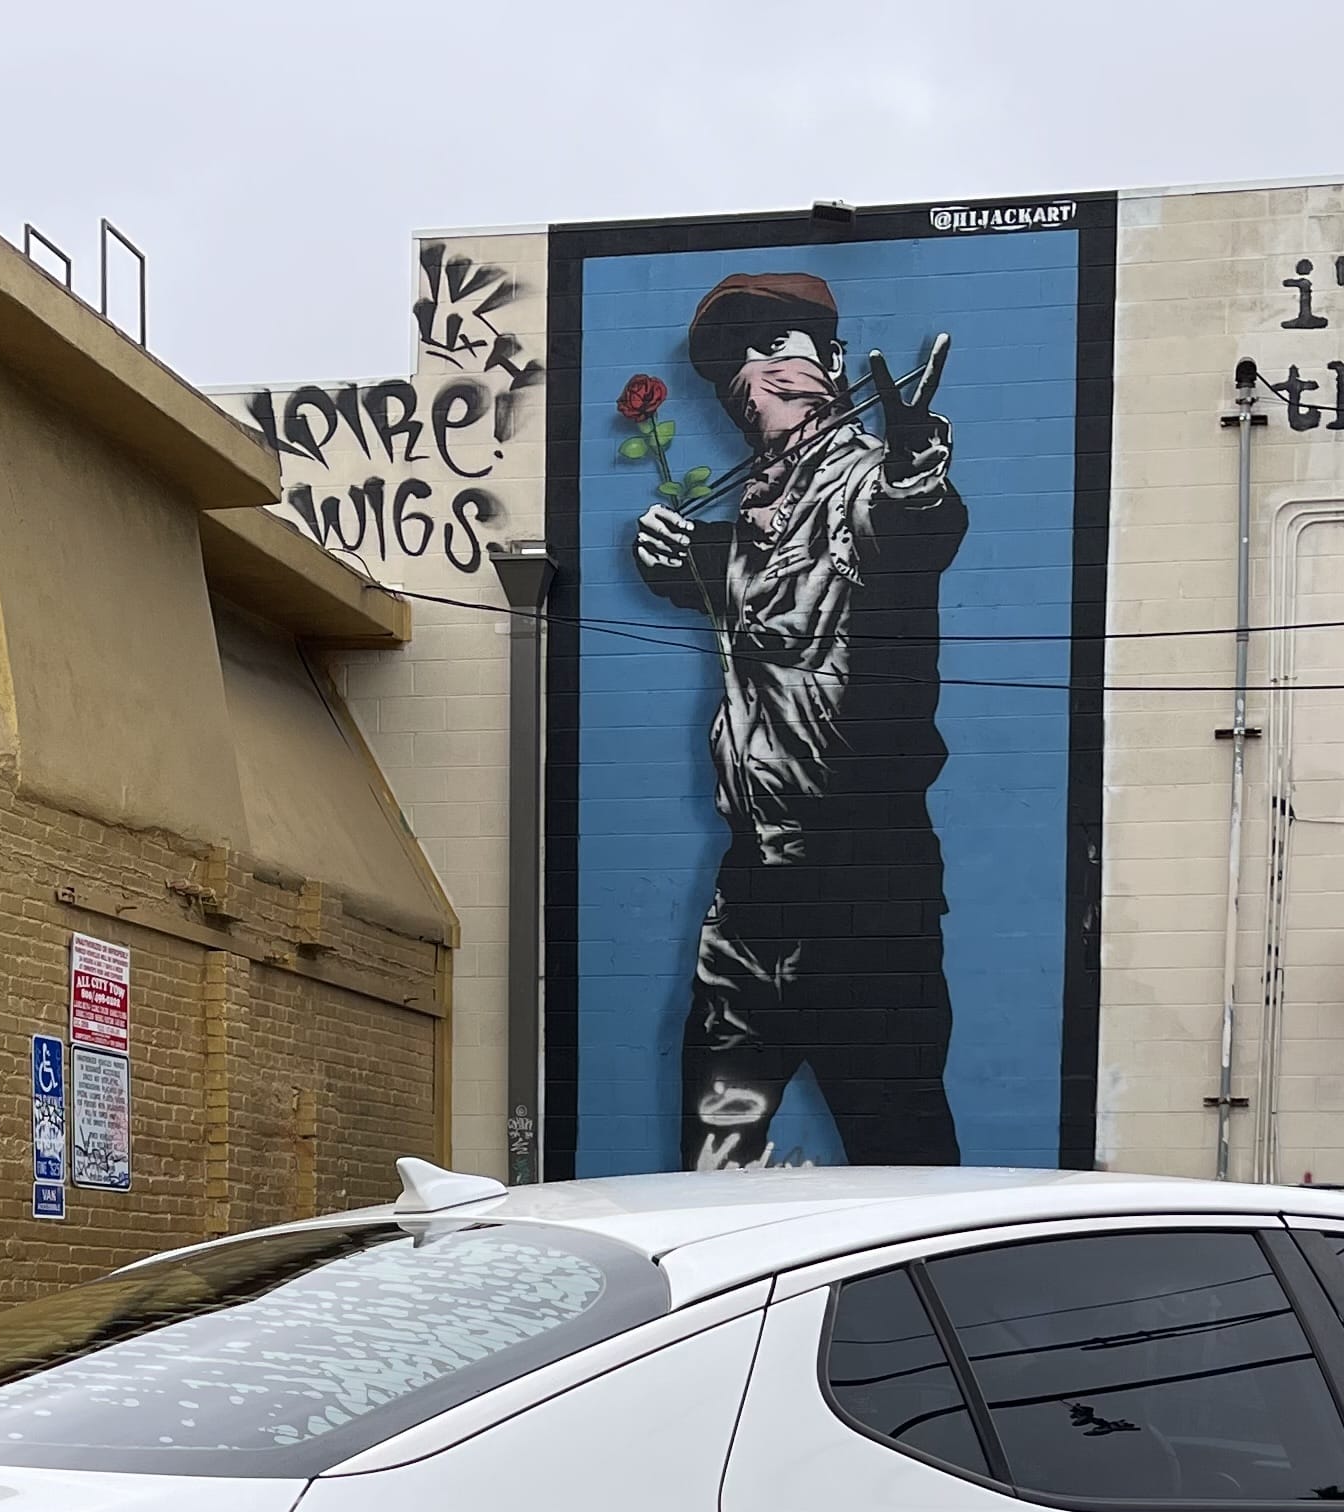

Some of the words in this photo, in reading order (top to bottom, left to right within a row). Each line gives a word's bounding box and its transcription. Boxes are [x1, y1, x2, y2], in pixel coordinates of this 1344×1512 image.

[934, 205, 1072, 232] @HIJACKART
[76, 976, 90, 988] ALL
[91, 977, 109, 991] CITY
